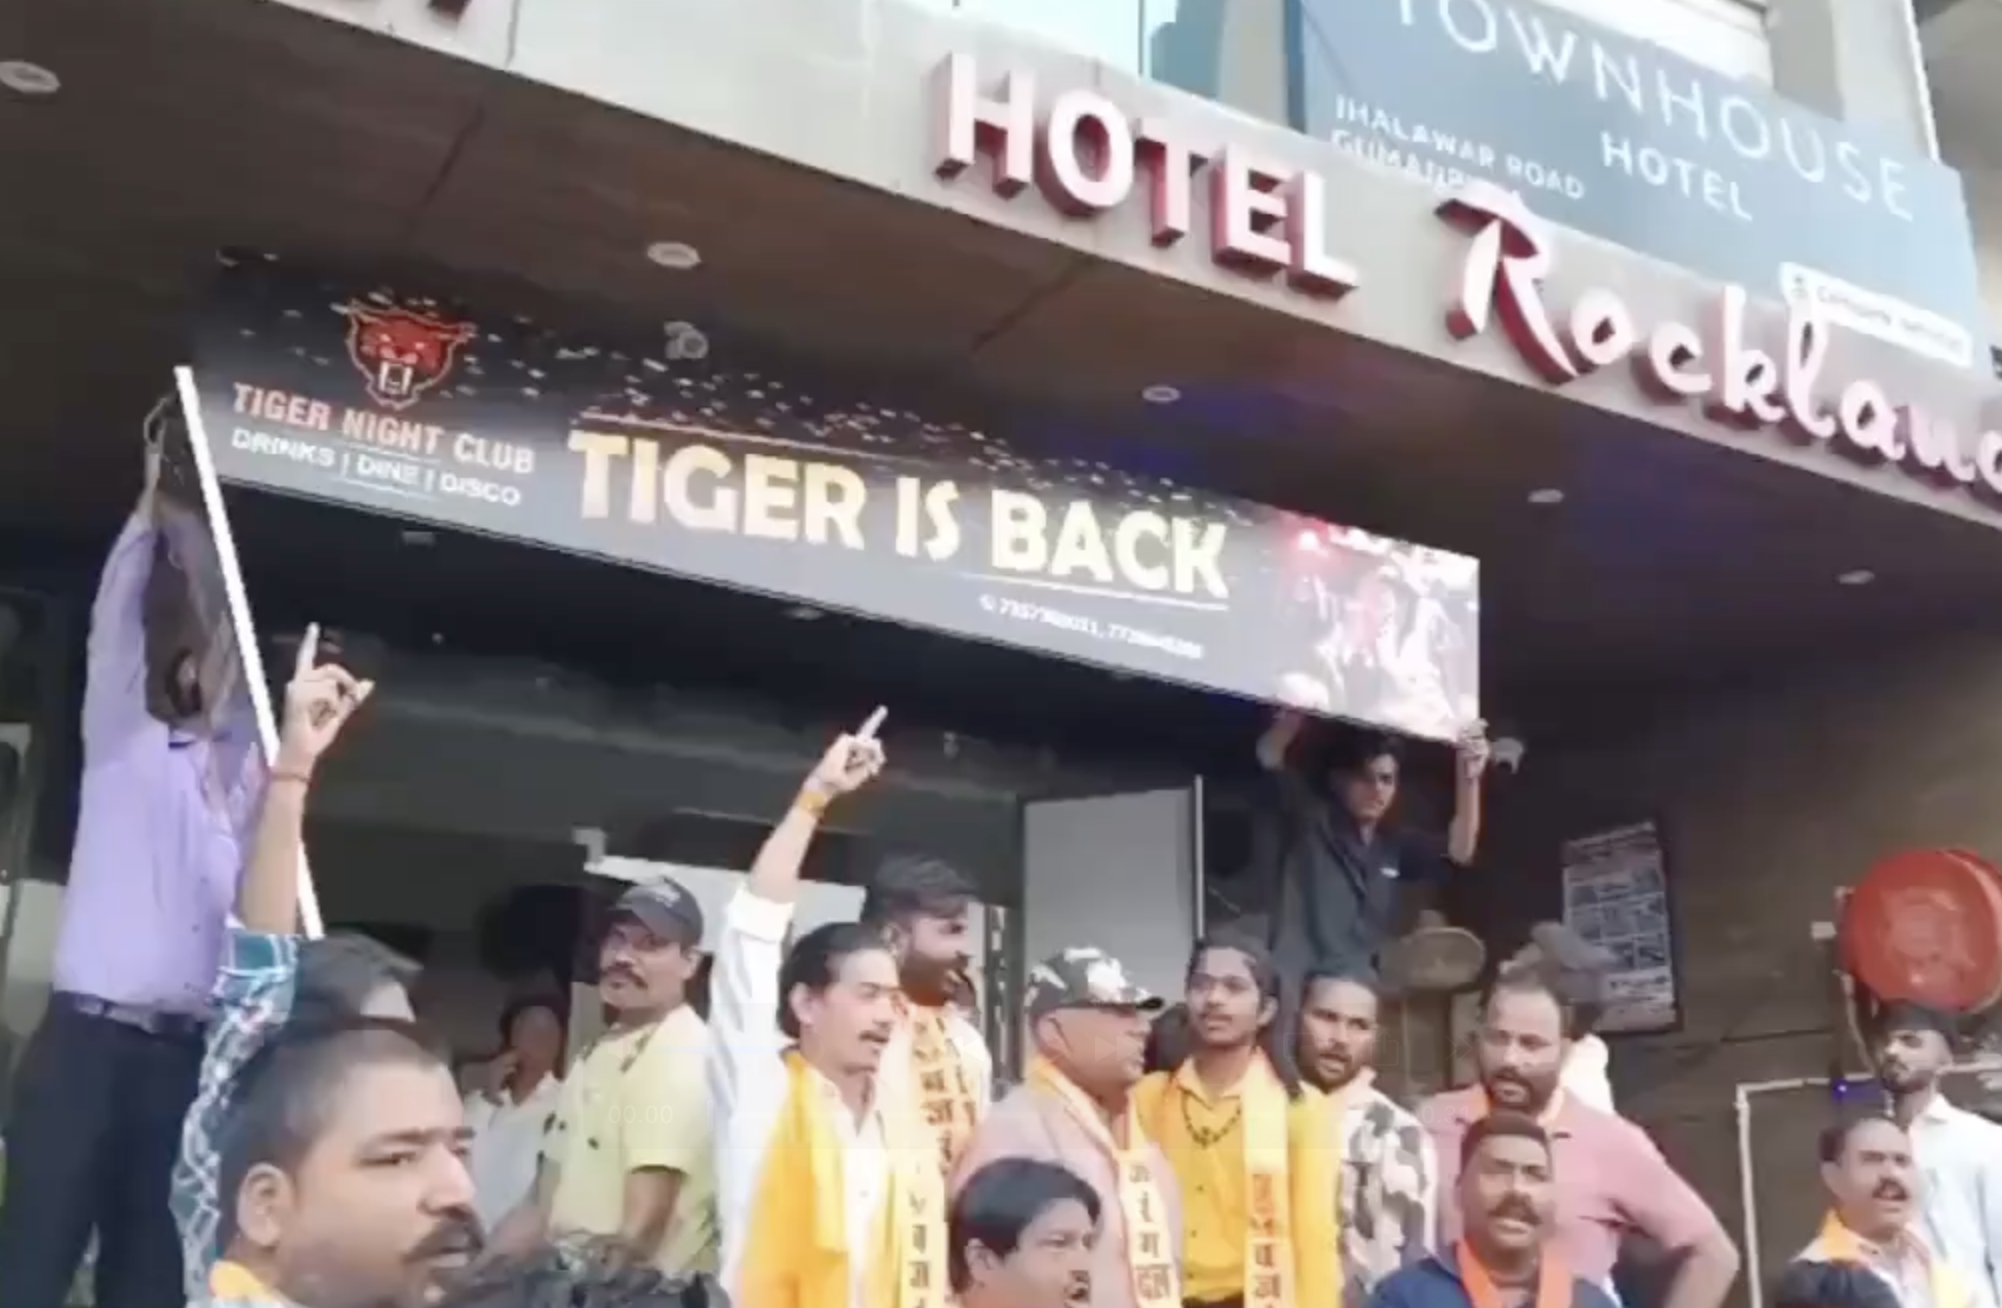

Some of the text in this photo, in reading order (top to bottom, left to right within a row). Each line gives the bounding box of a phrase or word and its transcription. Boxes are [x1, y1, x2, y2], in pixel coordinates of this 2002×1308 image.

[934, 50, 1360, 298] HOTEL
[1506, 153, 1586, 201] ROAD
[1600, 130, 1753, 222] HOTEL
[230, 427, 337, 468] DRINKS
[356, 454, 419, 484] DINE
[439, 471, 522, 507] DISCO
[232, 381, 536, 475] TIGER NIGHT CLUB
[568, 427, 1231, 599] TIGER IS BACK
